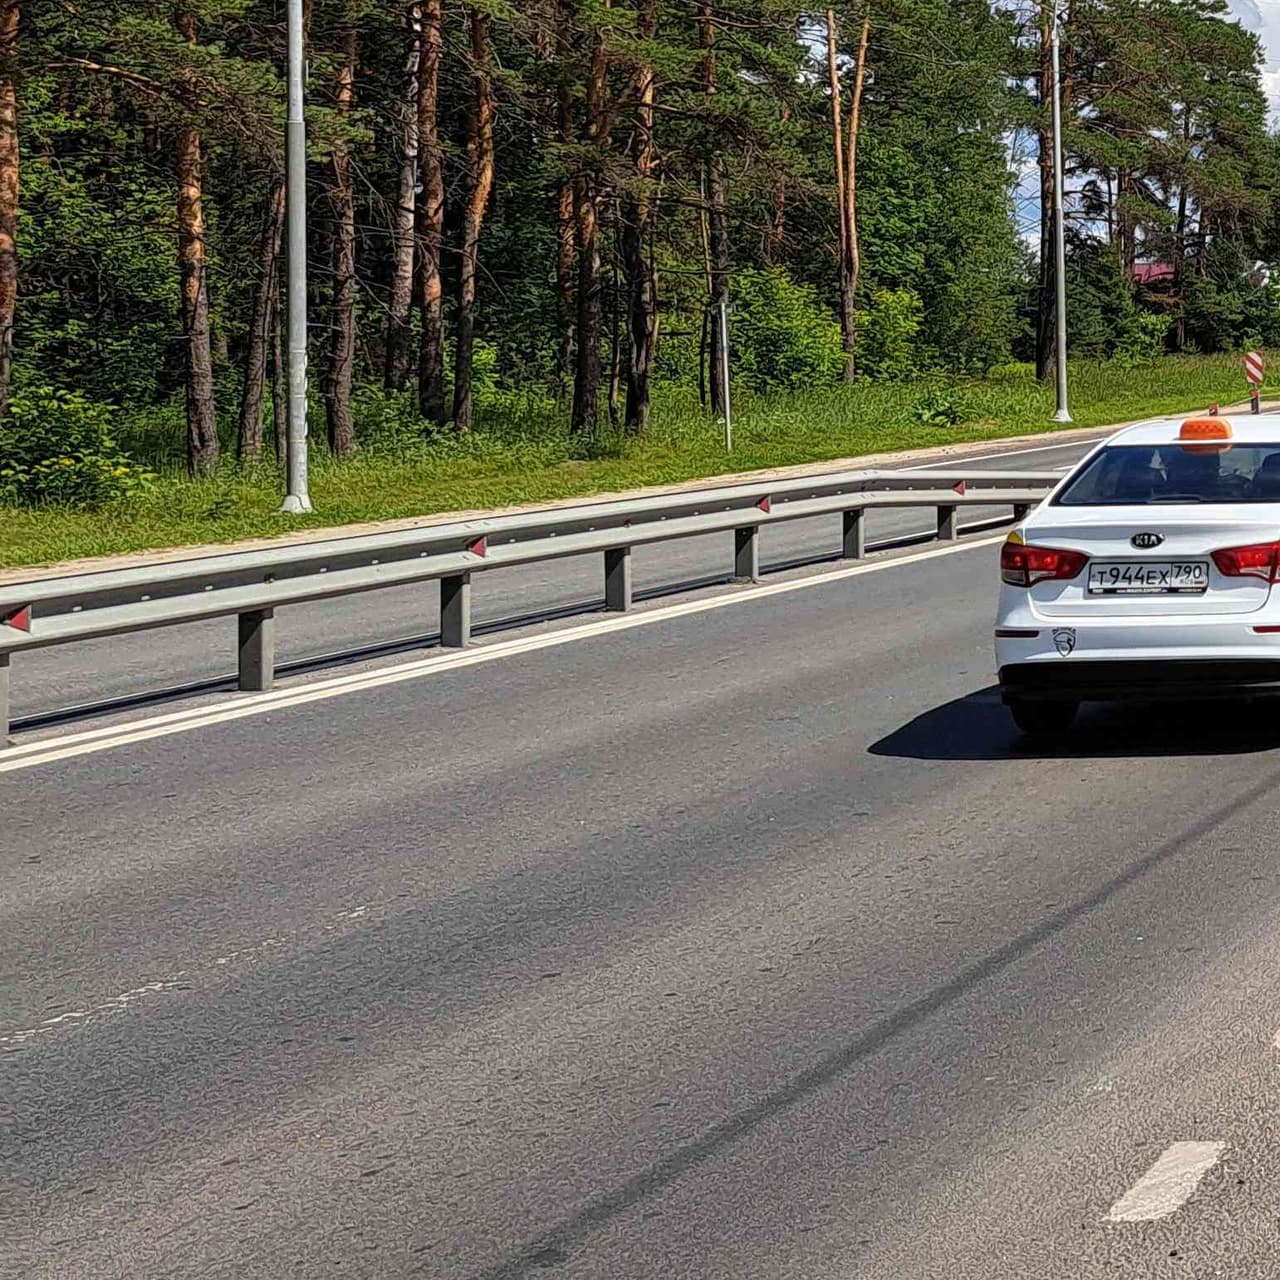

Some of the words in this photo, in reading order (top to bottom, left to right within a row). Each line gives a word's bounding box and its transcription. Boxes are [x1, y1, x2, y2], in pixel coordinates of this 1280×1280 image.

[1135, 535, 1158, 545] KIA
[1097, 566, 1170, 585] Т944ЕХ
[1174, 564, 1203, 580] 790
